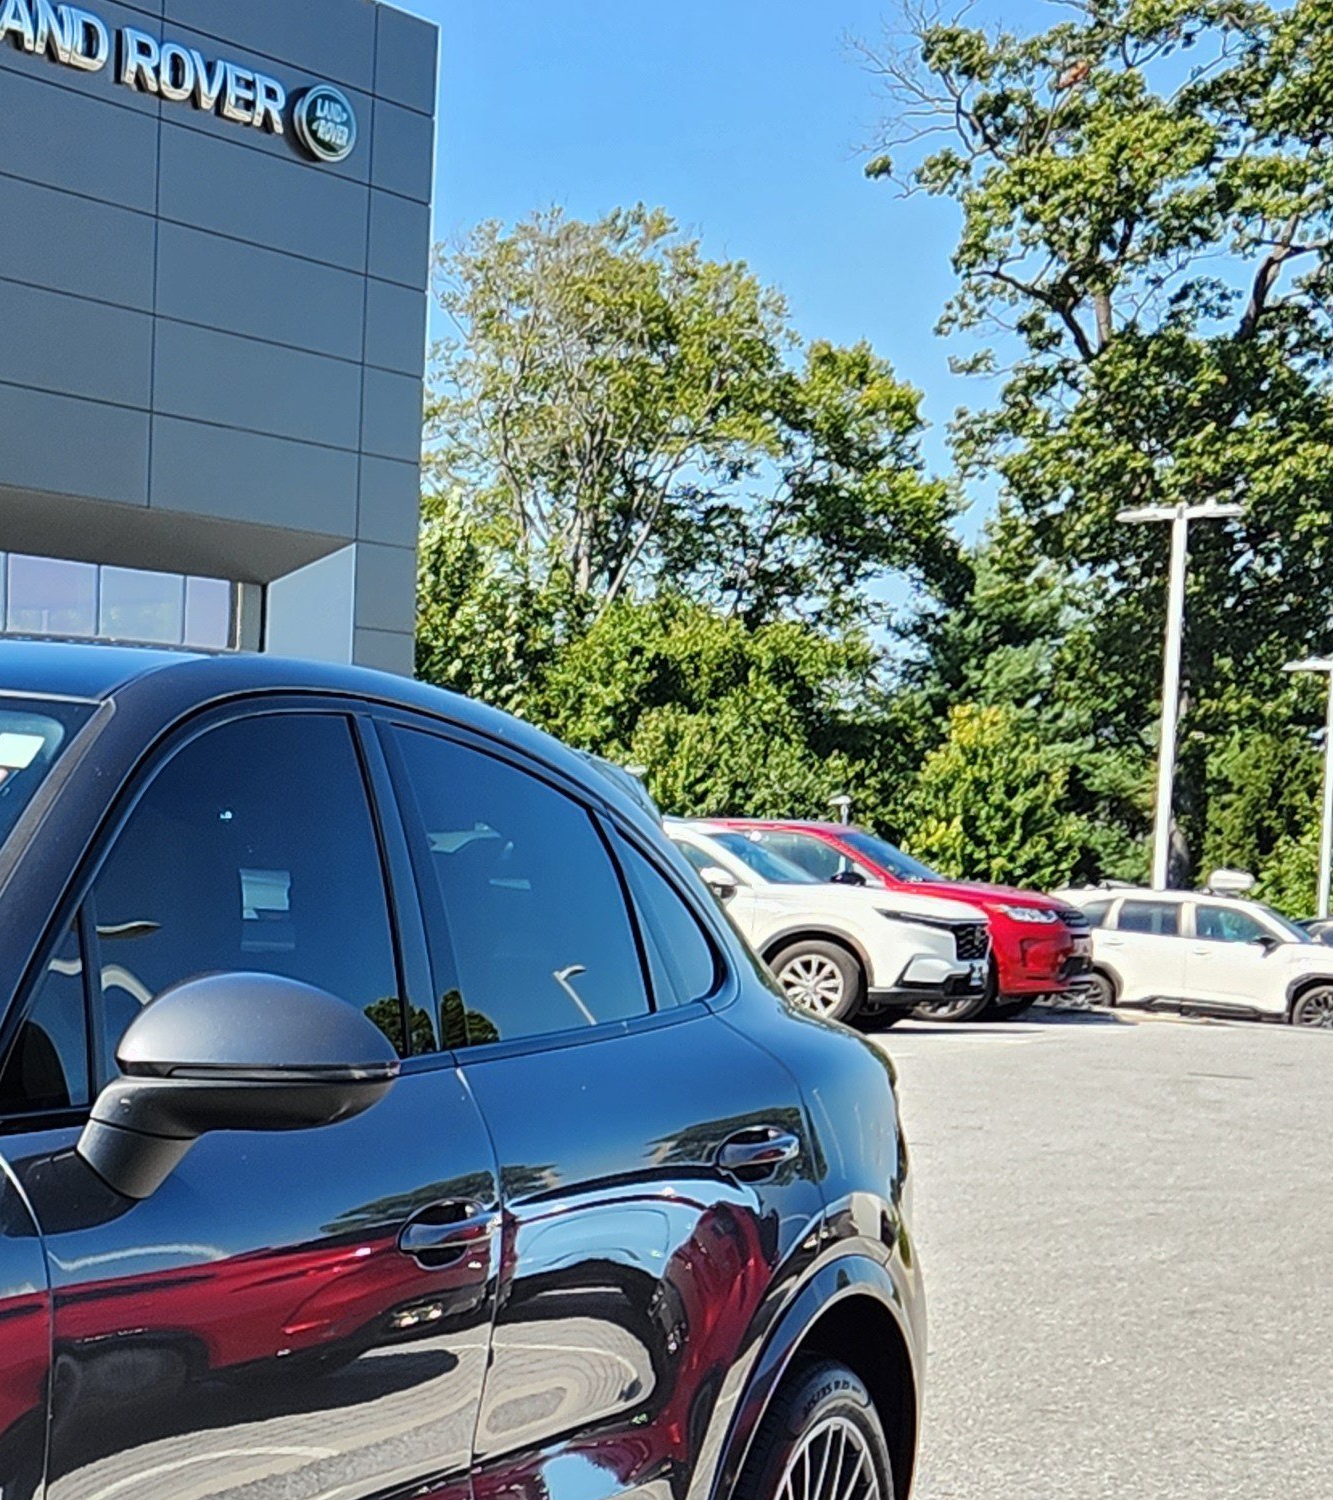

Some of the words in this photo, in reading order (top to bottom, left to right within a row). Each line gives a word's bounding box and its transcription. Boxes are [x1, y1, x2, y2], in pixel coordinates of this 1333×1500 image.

[121, 27, 288, 137] ROVER
[315, 97, 343, 123] LAND
[316, 119, 349, 147] ROVER
